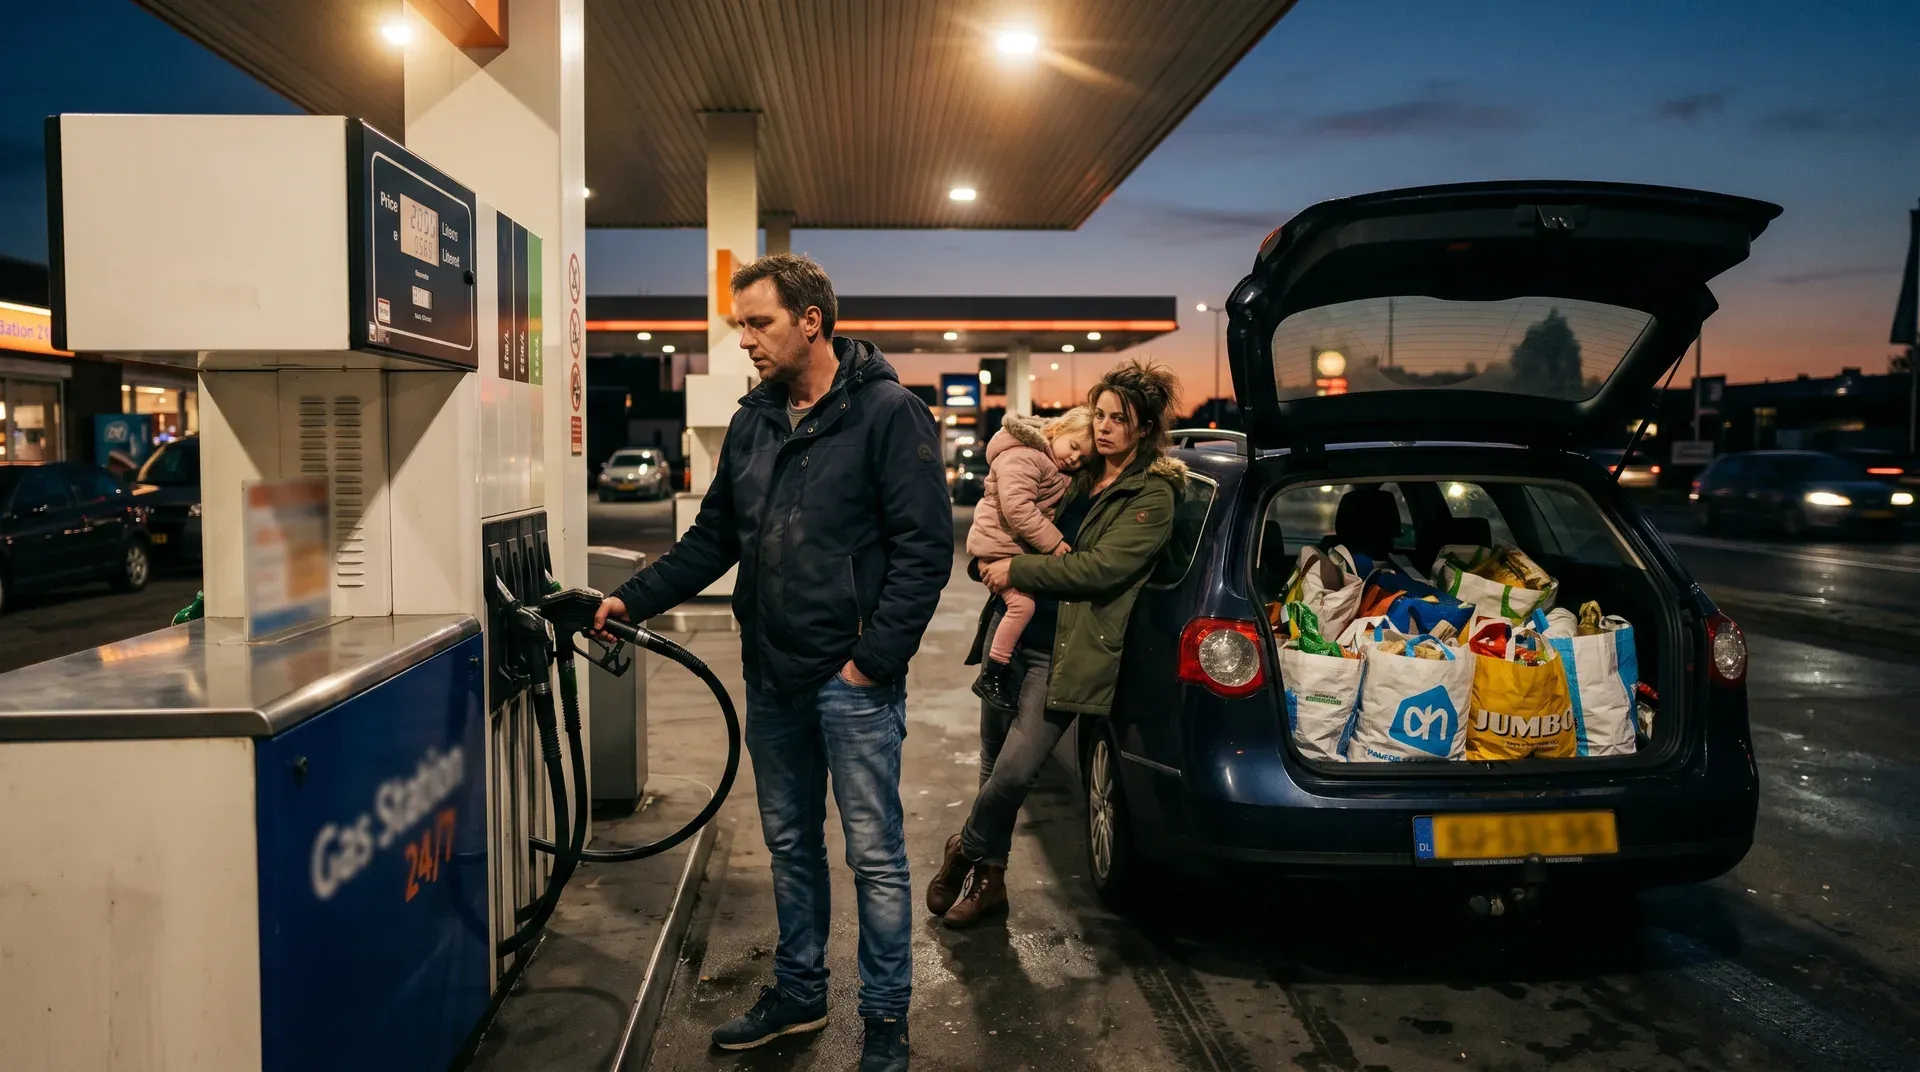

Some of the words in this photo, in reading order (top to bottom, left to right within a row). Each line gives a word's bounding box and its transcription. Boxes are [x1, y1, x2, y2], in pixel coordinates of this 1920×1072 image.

[380, 190, 399, 213] Price
[1473, 708, 1575, 739] JUMBO
[404, 808, 456, 903] 24/7
